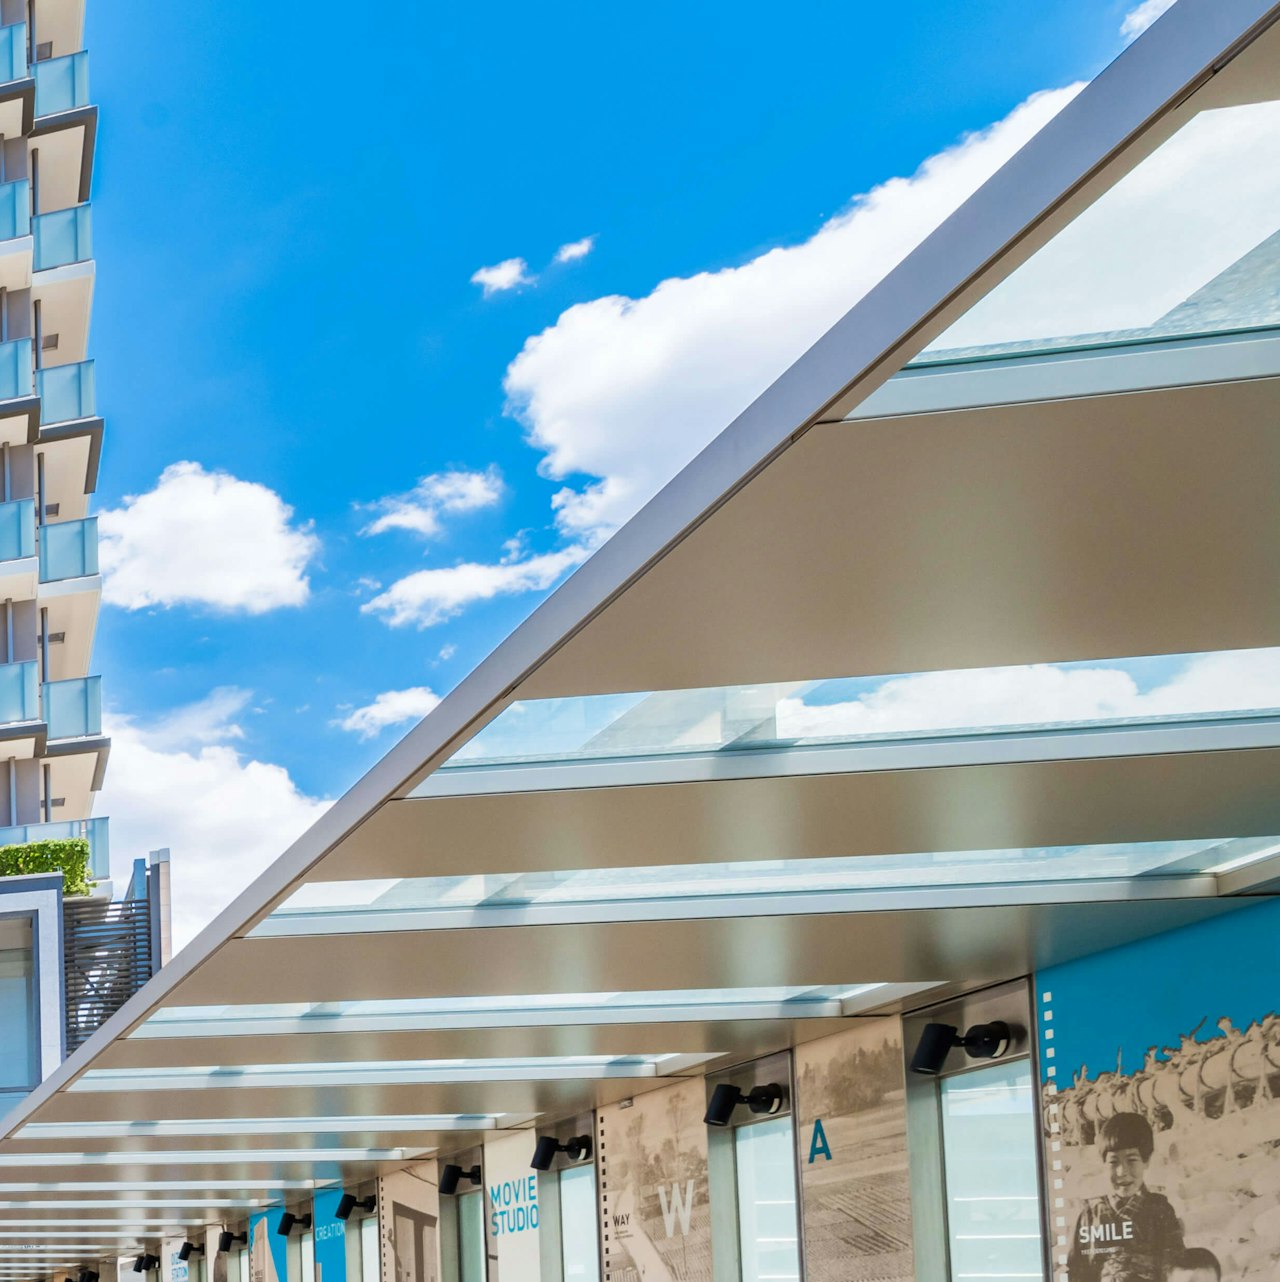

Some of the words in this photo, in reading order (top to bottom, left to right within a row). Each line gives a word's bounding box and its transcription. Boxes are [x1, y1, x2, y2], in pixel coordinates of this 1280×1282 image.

[807, 1118, 832, 1164] A
[490, 1175, 537, 1209] MOVIE
[491, 1204, 539, 1236] STUDIO
[612, 1213, 630, 1227] WAY
[658, 1179, 695, 1238] W
[315, 1222, 345, 1241] CREATION
[1079, 1221, 1134, 1244] SMILE
